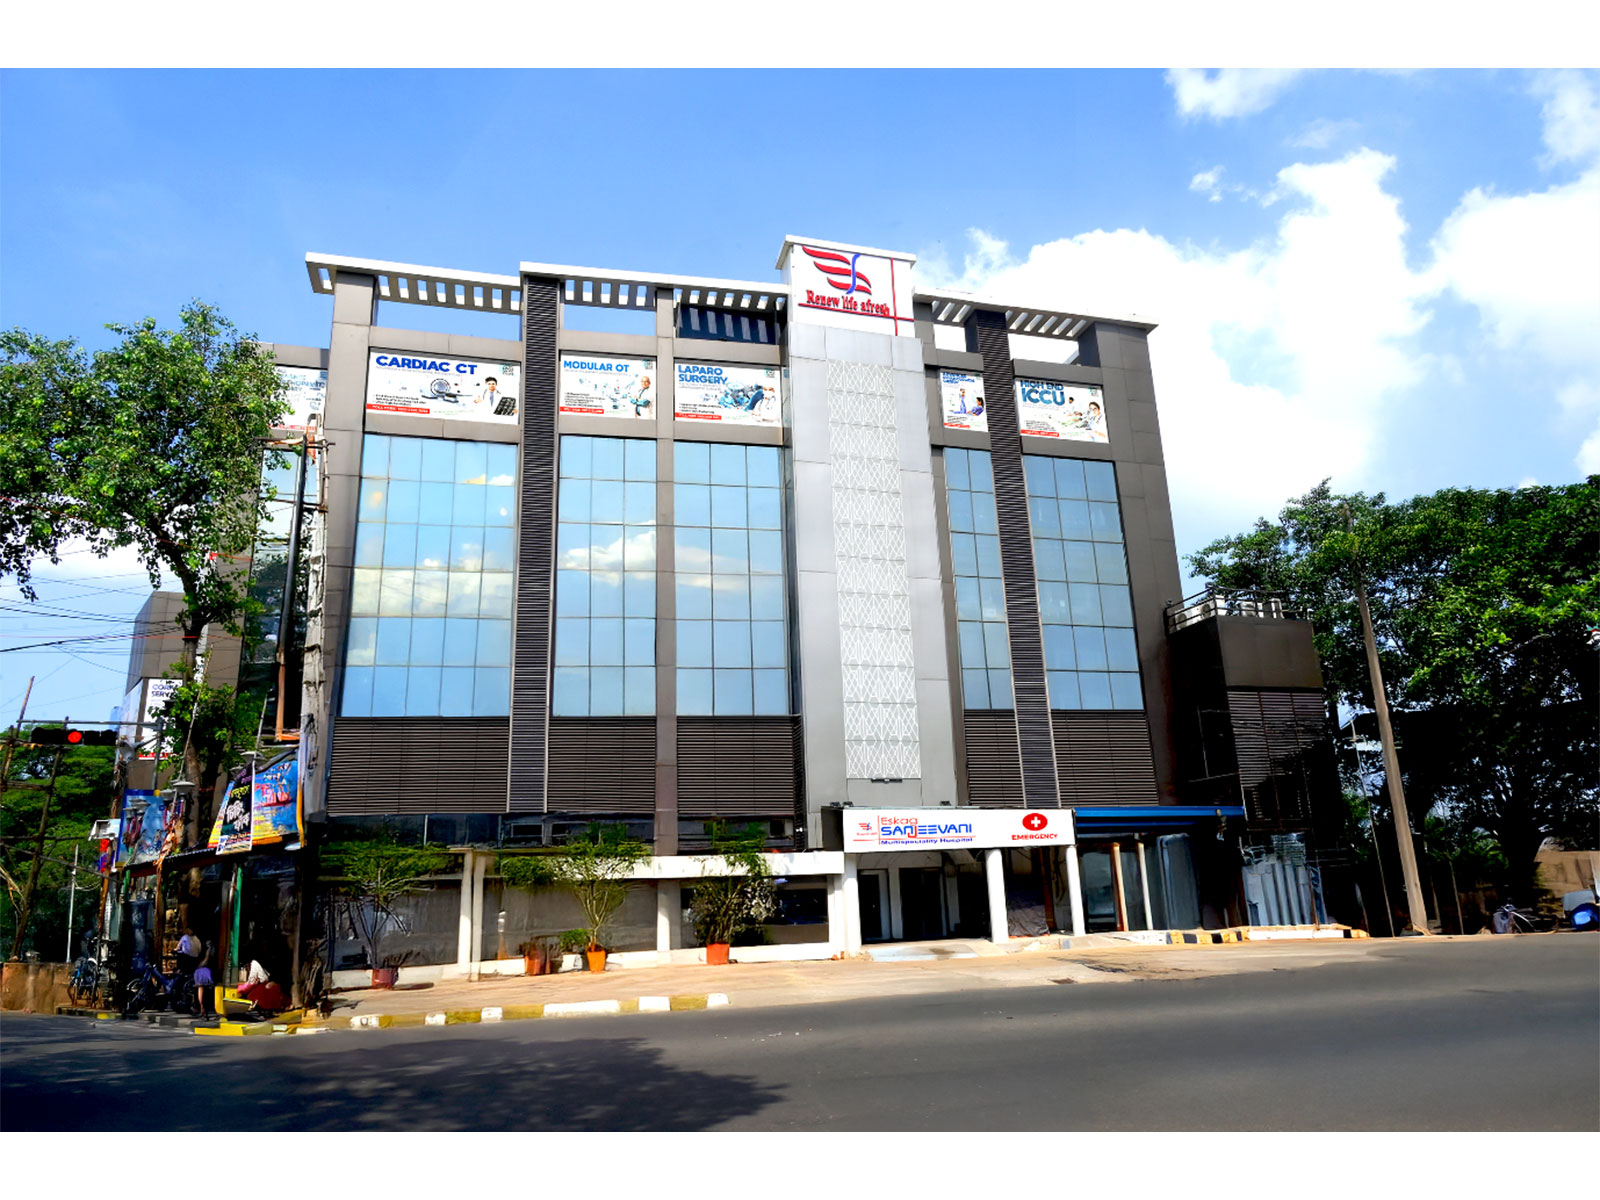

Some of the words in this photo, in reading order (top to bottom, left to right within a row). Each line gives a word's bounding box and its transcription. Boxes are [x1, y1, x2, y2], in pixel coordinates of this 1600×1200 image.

[806, 289, 840, 307] Renew
[842, 295, 858, 311] life
[860, 298, 890, 317] afresh
[375, 355, 451, 372] CARDIAC
[455, 363, 478, 375] CT
[563, 360, 613, 371] MODULAR
[615, 364, 630, 373] OT
[677, 364, 723, 376] LAPARO
[678, 373, 728, 385] SURGERY
[1020, 379, 1045, 389] HIGH
[1045, 382, 1064, 391] END
[1021, 387, 1066, 406] ICCU
[880, 816, 918, 826] Eskag
[880, 823, 972, 838] SANJEEVANI
[1011, 833, 1058, 841] EMERGENCY
